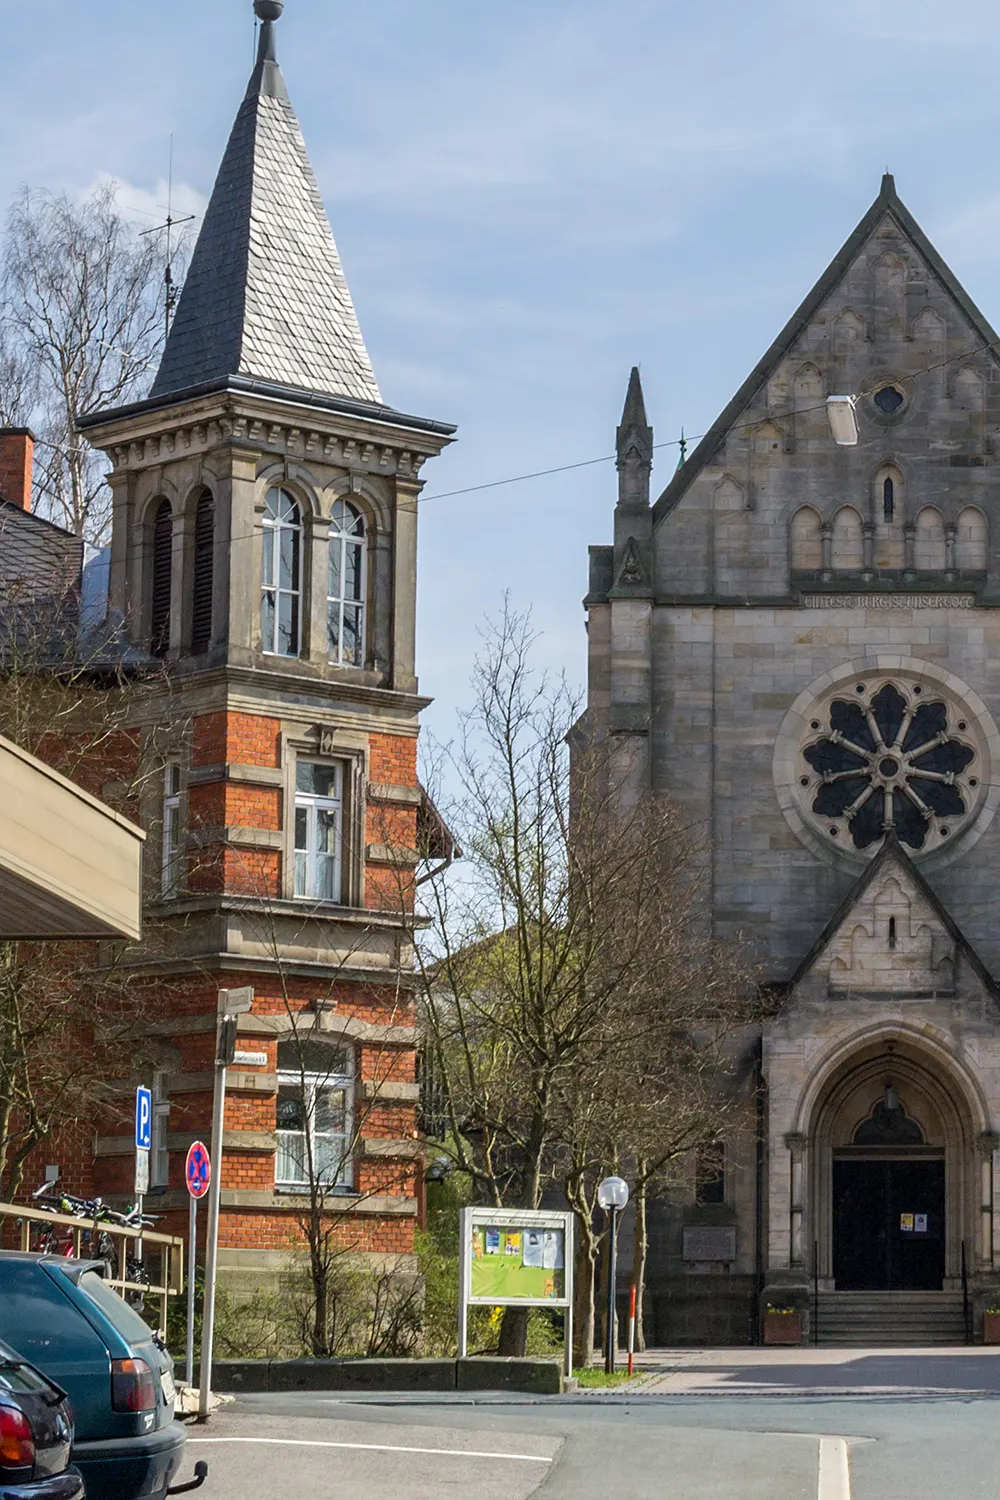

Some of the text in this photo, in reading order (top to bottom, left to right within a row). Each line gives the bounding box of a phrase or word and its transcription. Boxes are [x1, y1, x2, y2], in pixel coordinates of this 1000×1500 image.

[857, 595, 887, 608] BURG
[888, 595, 906, 608] IST
[906, 595, 943, 608] UNSER
[140, 1095, 149, 1140] P
